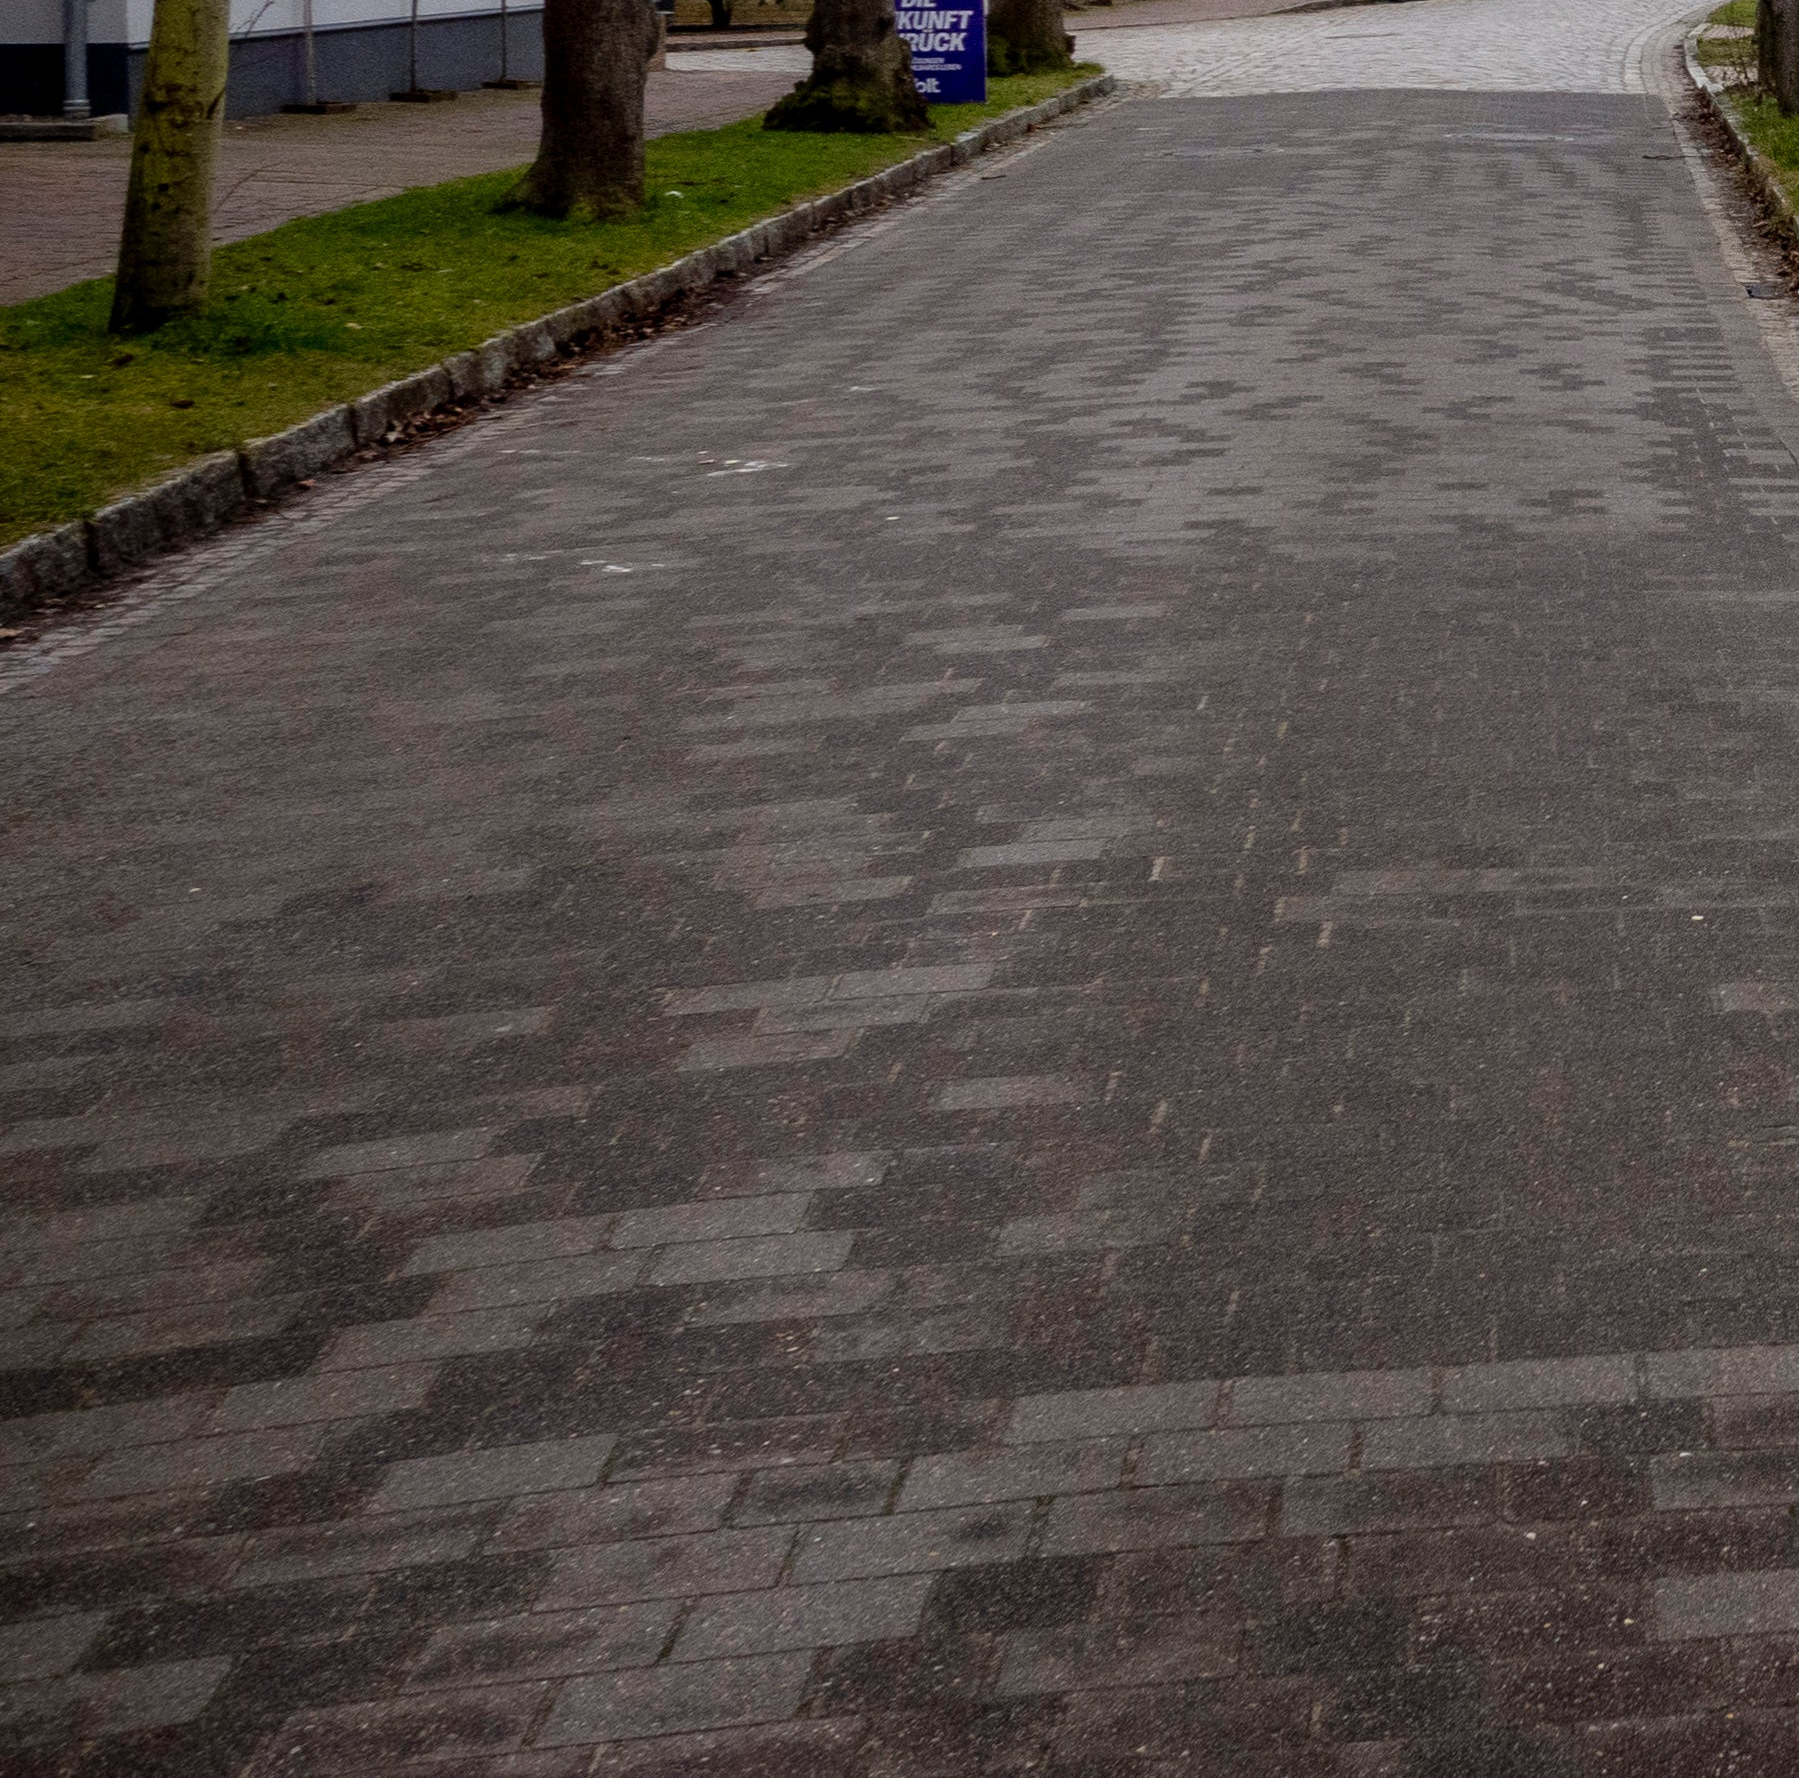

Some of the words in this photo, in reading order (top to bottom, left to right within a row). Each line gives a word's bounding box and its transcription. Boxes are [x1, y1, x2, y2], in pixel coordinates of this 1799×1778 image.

[894, 10, 974, 30] KUNFT
[899, 29, 967, 52] RÜCK
[914, 78, 941, 93] olt
